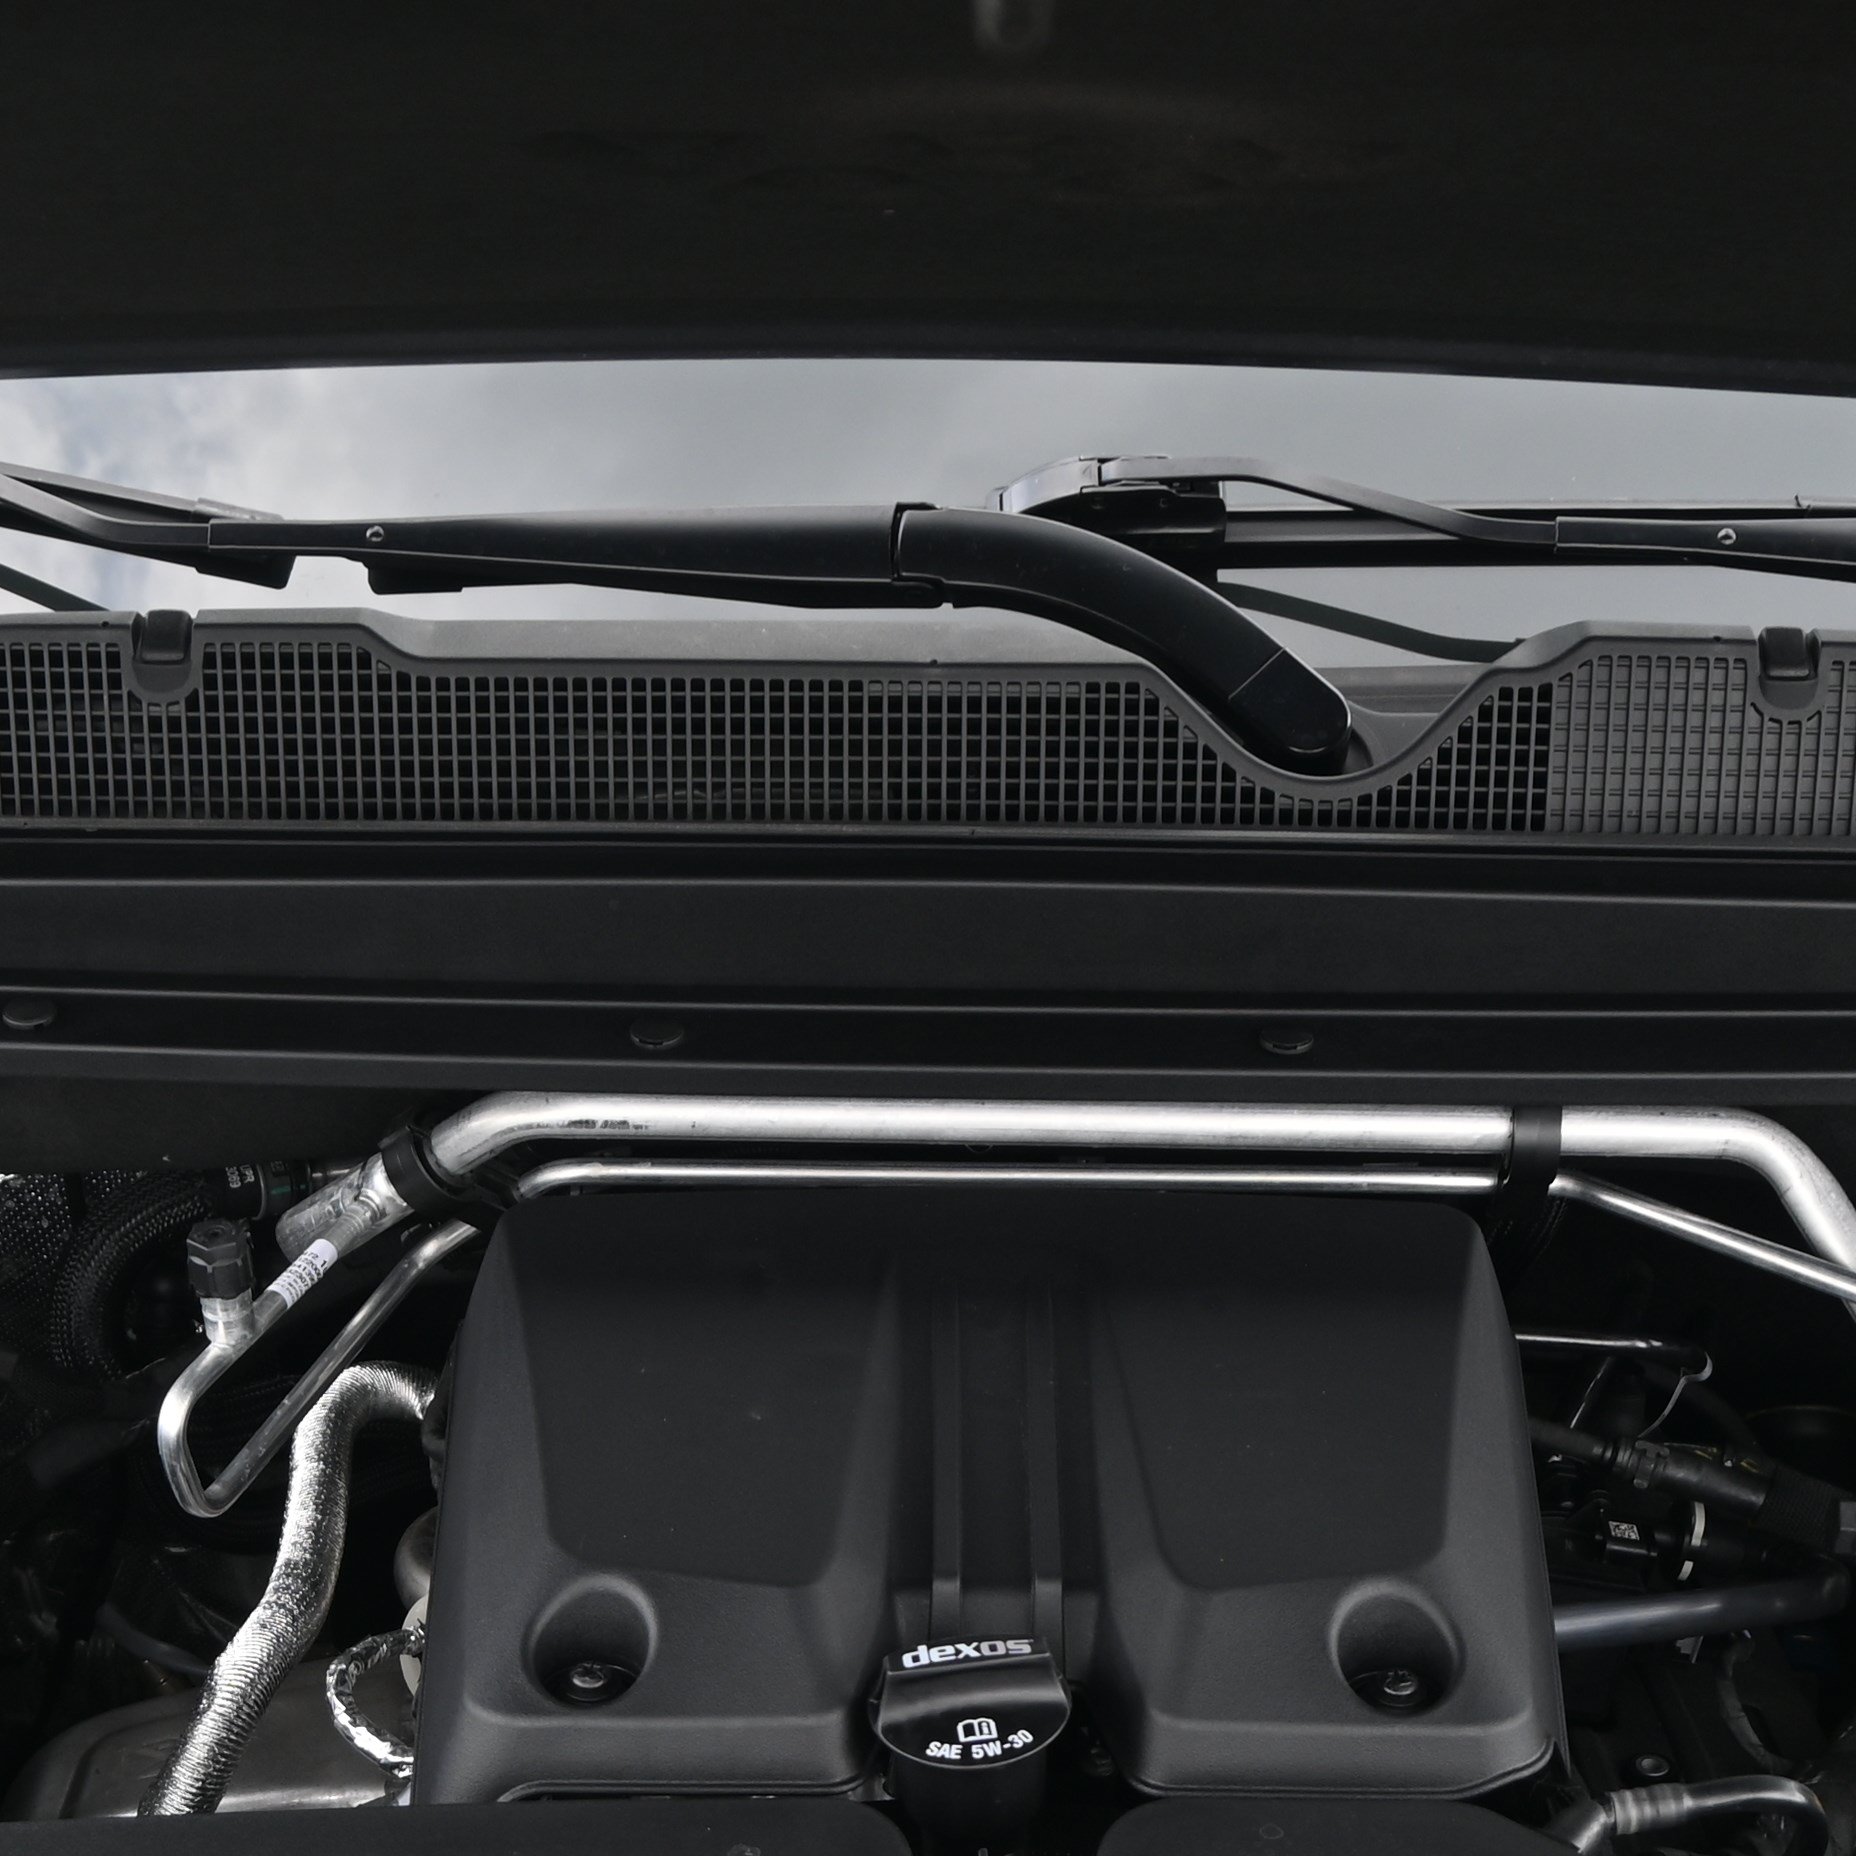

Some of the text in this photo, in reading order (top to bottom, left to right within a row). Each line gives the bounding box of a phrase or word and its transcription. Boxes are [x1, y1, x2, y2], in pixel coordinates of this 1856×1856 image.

[902, 1639, 1032, 1668] dexos
[925, 1730, 1034, 1760] SAE 5W-30
